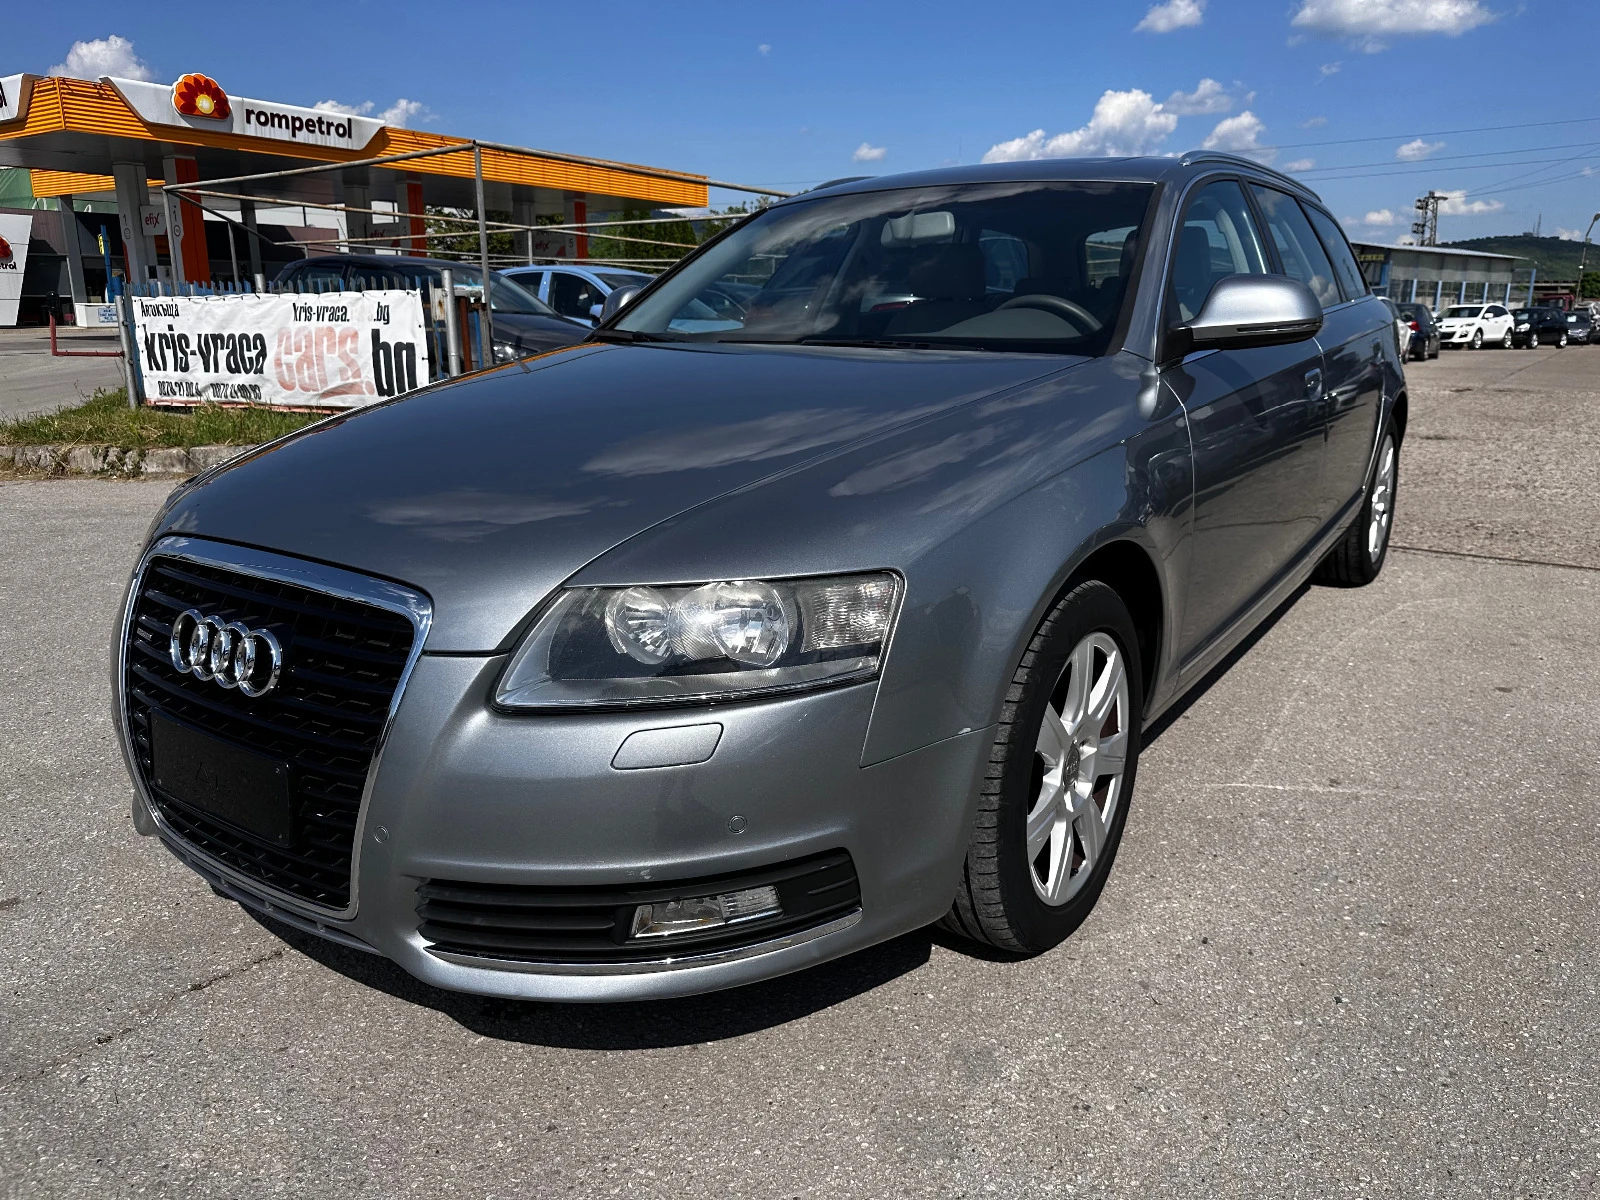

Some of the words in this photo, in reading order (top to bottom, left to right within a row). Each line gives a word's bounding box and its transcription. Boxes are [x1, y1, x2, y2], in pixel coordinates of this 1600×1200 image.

[245, 108, 353, 139] rompetrol
[144, 212, 160, 228] efix
[140, 302, 180, 319] Автокъща
[142, 323, 268, 375] kris-vraca
